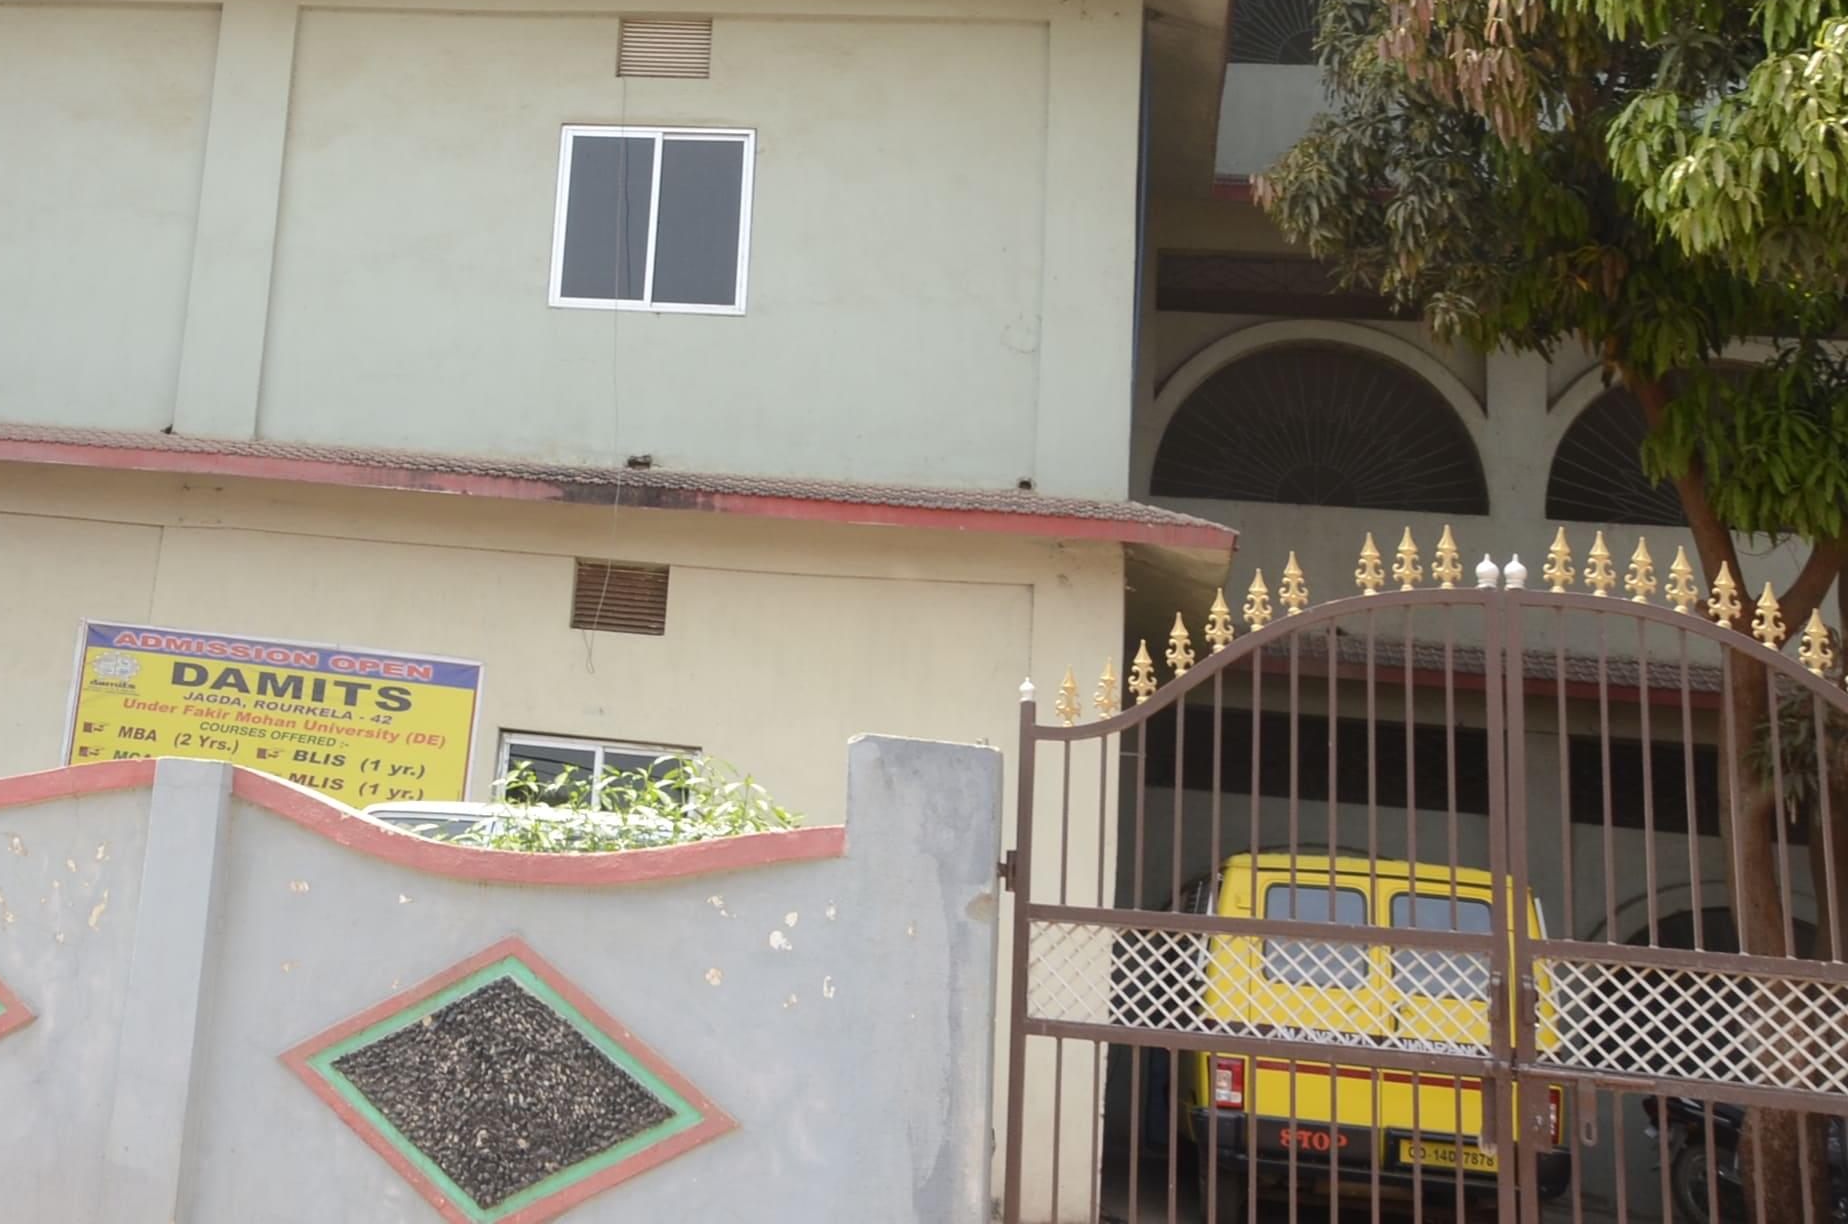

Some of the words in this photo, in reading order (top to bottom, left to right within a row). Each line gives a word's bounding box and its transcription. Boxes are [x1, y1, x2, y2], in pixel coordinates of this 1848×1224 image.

[114, 631, 318, 667] ADMISSION
[329, 655, 433, 681] OPEN
[171, 661, 412, 712] DAMITS
[123, 697, 178, 714] Under
[183, 704, 231, 720] Fakir
[235, 711, 296, 729] Mohan
[303, 719, 401, 744] University
[405, 732, 447, 749] (DE)
[183, 692, 247, 709] JAGDA,
[254, 699, 352, 721] ROURKELA
[370, 714, 393, 725] 42
[118, 725, 158, 742] MBA
[173, 732, 192, 748] (2
[199, 736, 240, 754] Yrs.)
[199, 721, 267, 739] COURSES
[270, 730, 337, 748] OFFERED
[113, 749, 153, 760] MC
[292, 749, 346, 767] BLIS
[360, 758, 382, 773] (1
[388, 763, 426, 780] yr.)
[289, 772, 345, 791] MLIS
